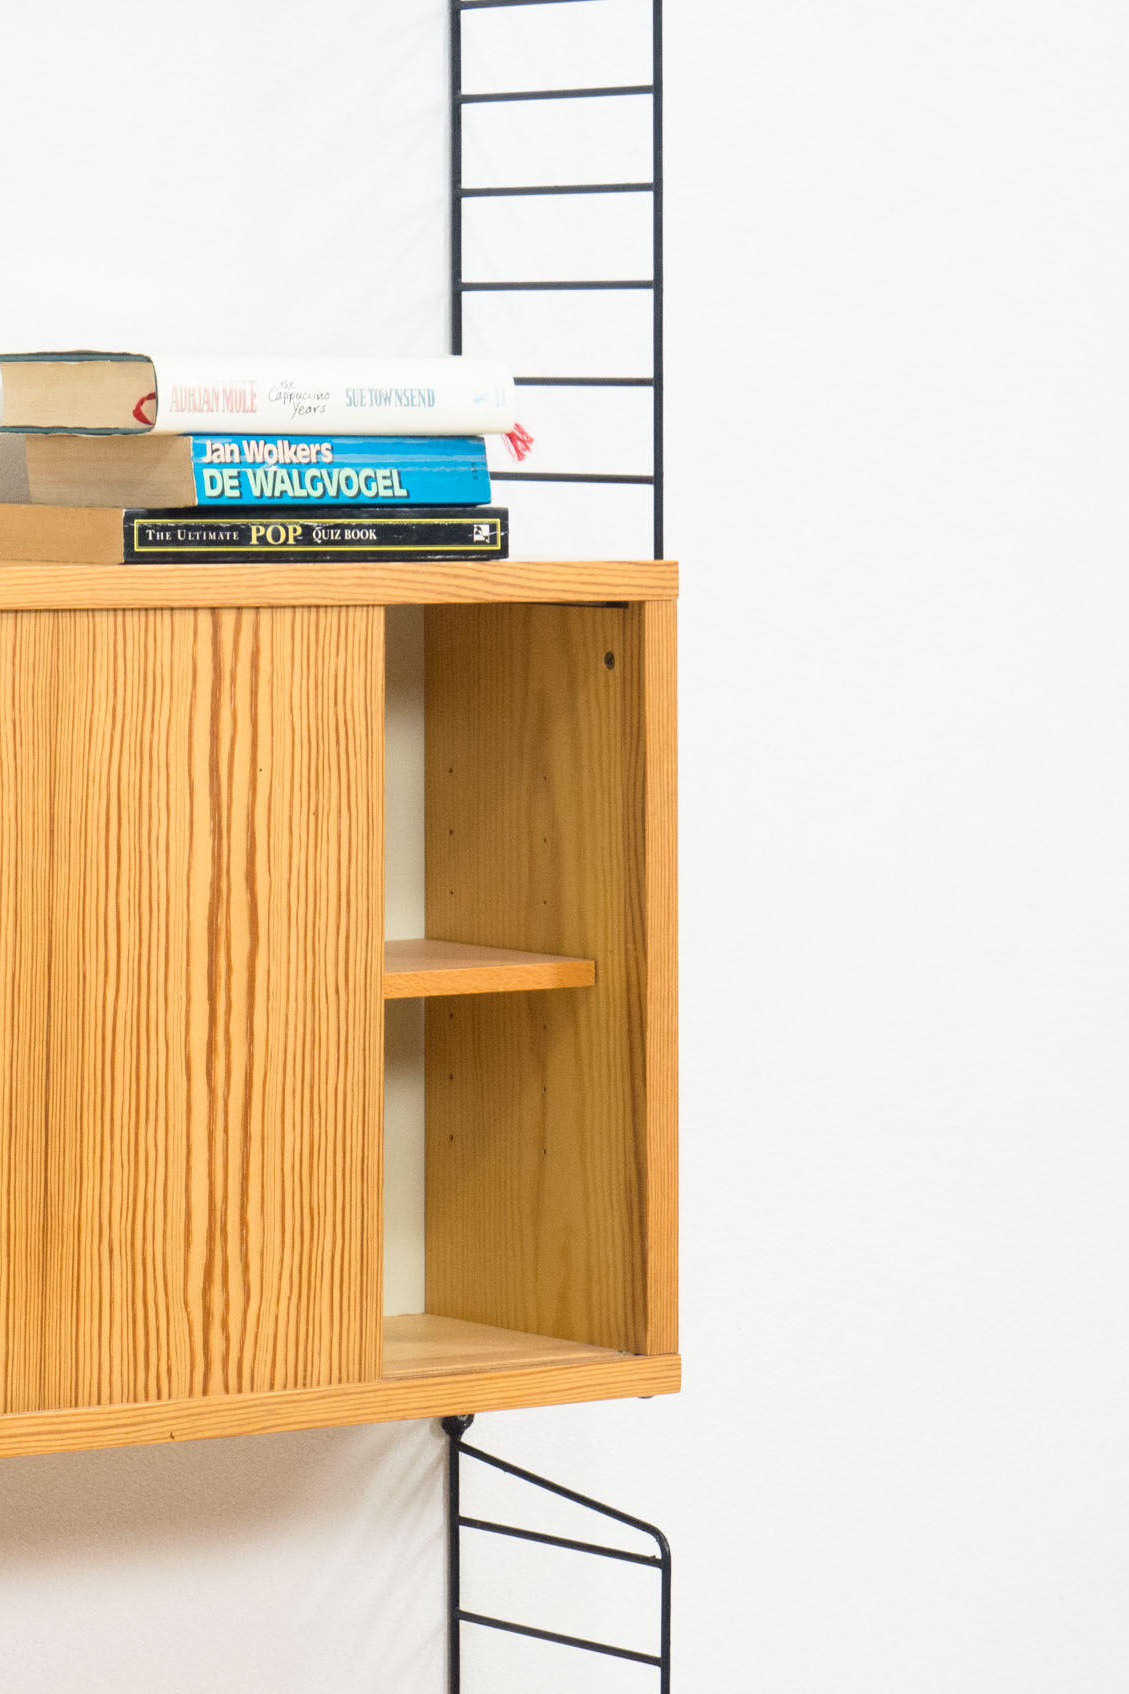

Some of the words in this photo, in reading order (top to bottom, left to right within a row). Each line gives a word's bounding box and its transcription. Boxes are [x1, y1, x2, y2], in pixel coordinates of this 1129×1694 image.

[170, 384, 219, 412] ADRIAN
[222, 380, 258, 413] MOLE
[268, 386, 331, 405] Cappuccino
[345, 388, 366, 407] SUE
[367, 388, 436, 407] TOWNSEND
[291, 401, 326, 420] Years
[202, 440, 241, 463] Jan
[242, 440, 334, 464] Wolkers
[203, 468, 242, 497] DE
[245, 468, 408, 498] WALGVOGEL
[249, 525, 302, 545] POP
[312, 529, 341, 544] QUIZ
[344, 528, 378, 541] BOOK
